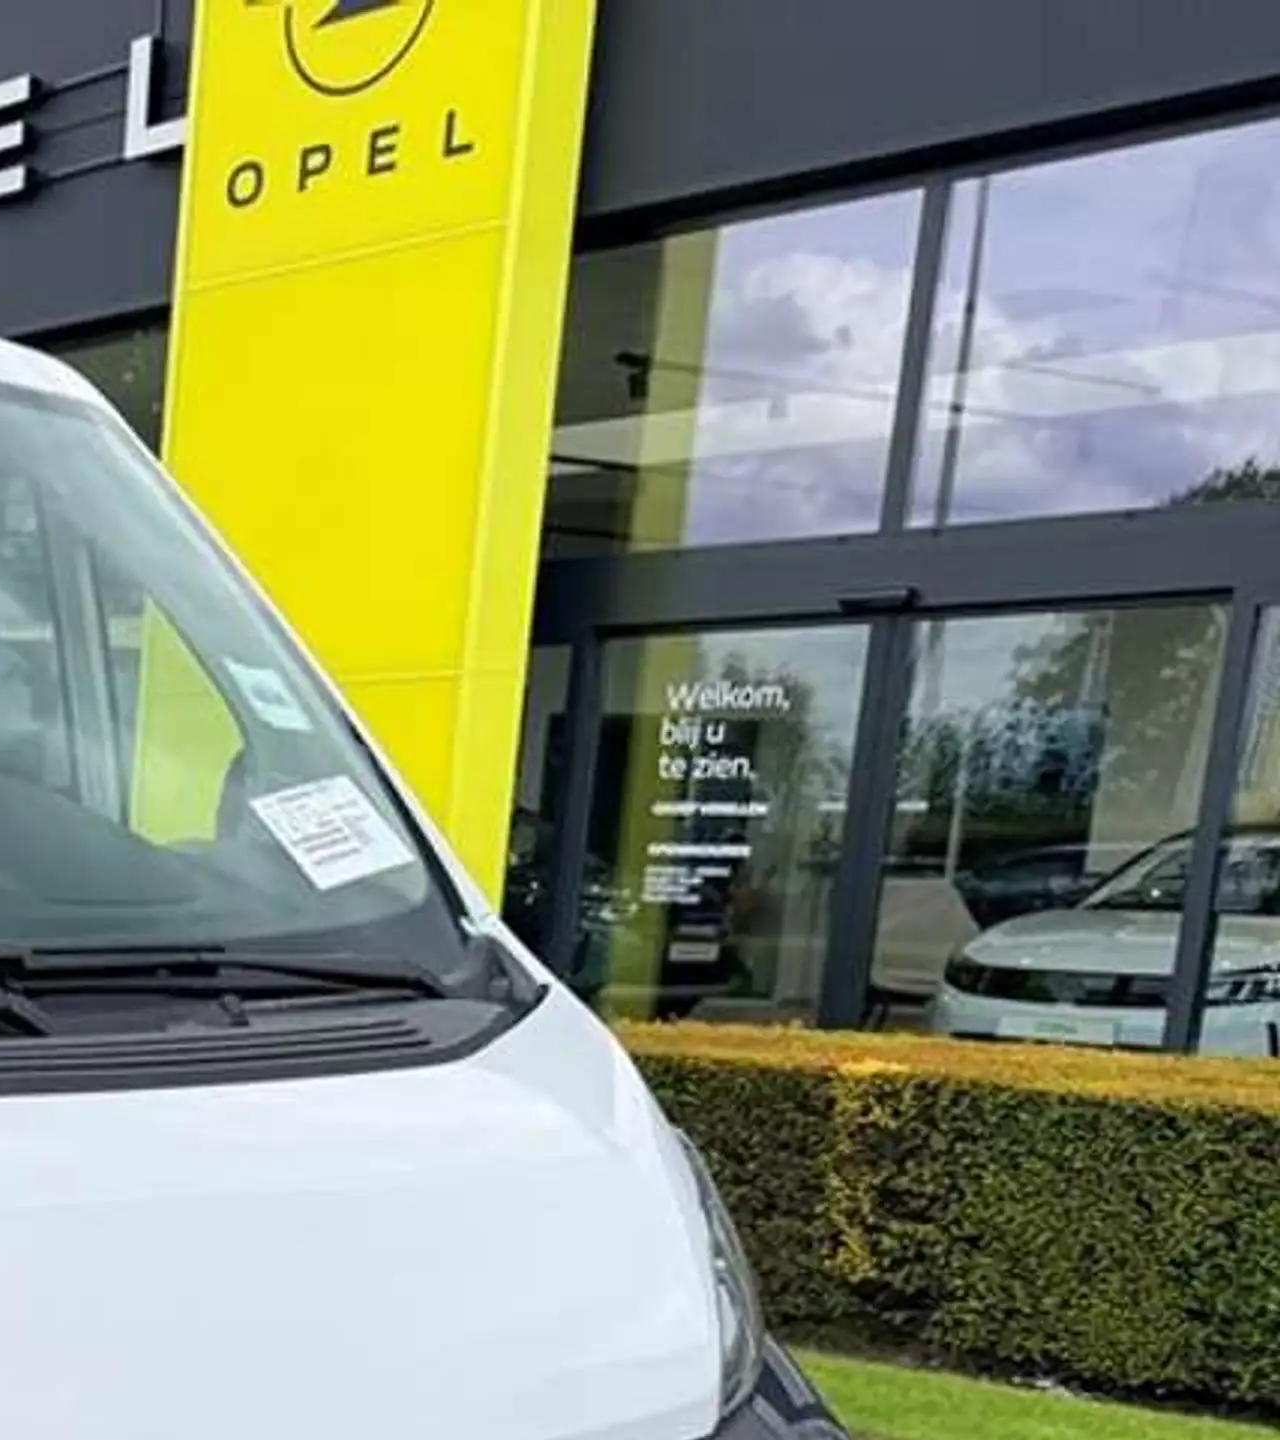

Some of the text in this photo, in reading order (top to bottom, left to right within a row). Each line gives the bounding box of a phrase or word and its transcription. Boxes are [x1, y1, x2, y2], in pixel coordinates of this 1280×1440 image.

[226, 108, 474, 208] OPEL
[666, 680, 791, 713] Welkom,
[706, 721, 726, 745] u
[658, 751, 688, 780] te
